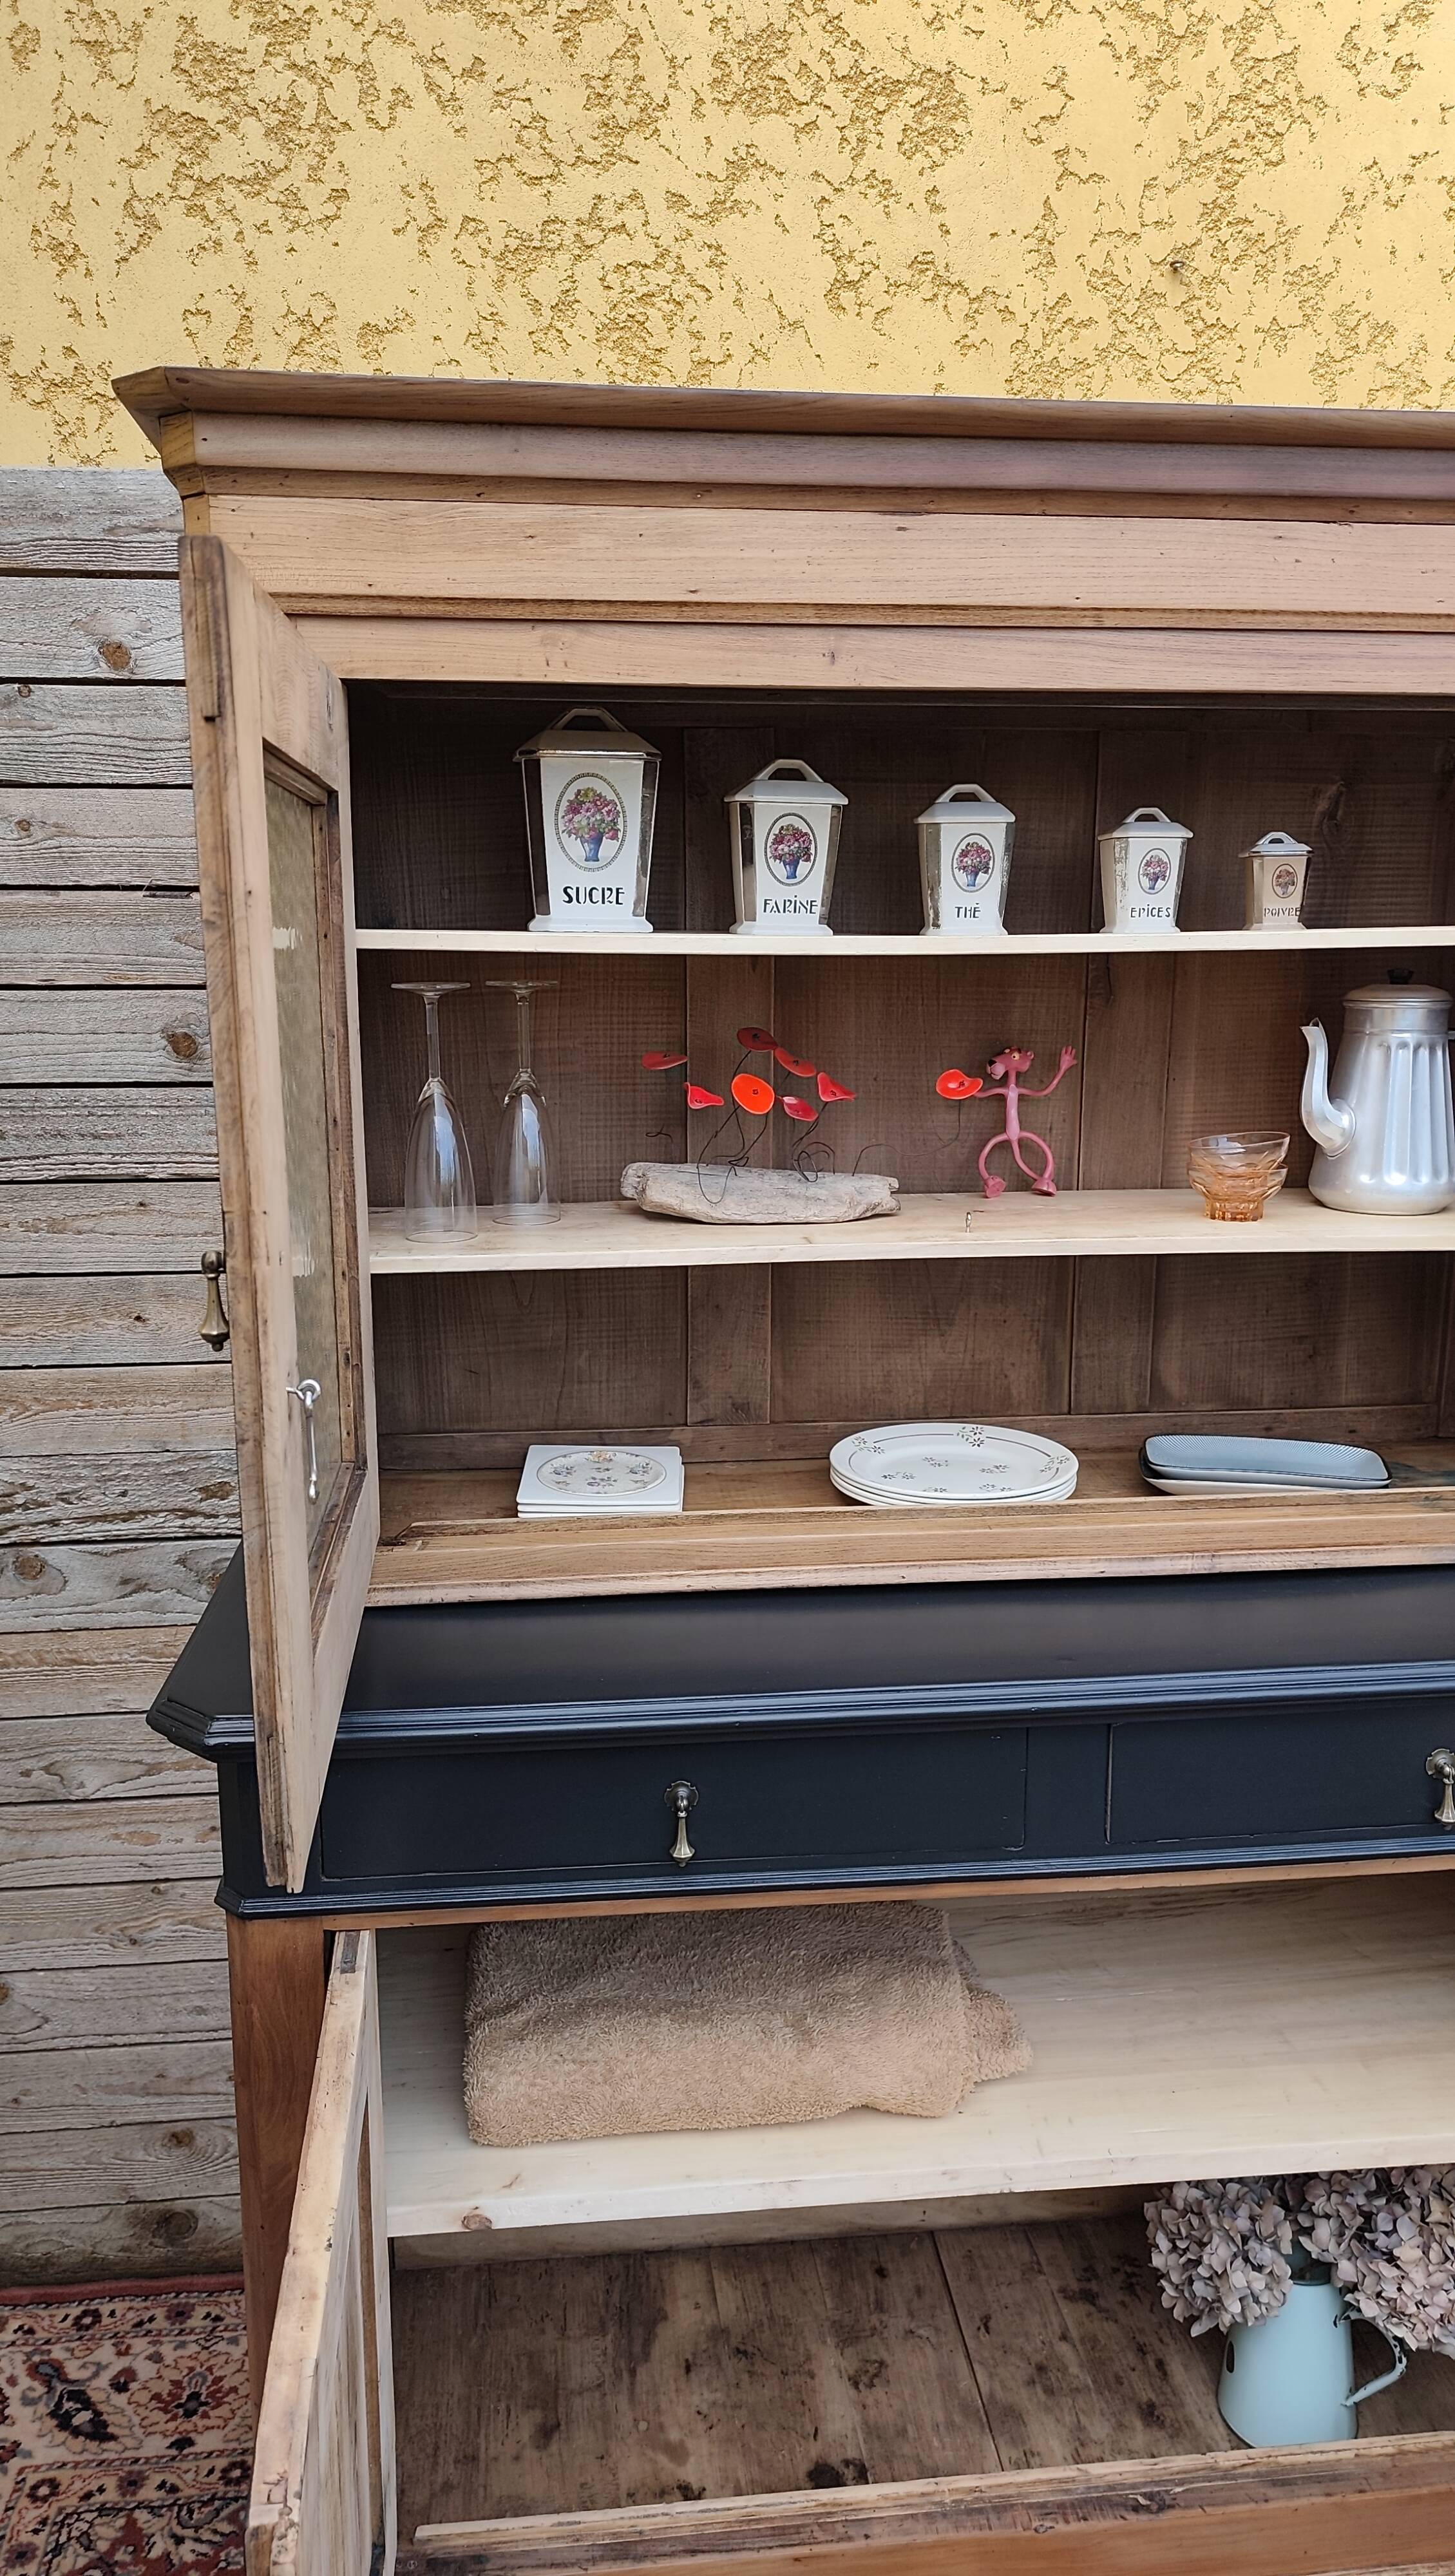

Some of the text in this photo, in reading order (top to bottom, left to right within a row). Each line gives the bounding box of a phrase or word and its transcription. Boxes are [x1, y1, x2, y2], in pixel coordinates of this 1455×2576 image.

[562, 886, 625, 905] SUCRE
[955, 902, 981, 918] THÉ
[1264, 907, 1301, 918] POIVRE
